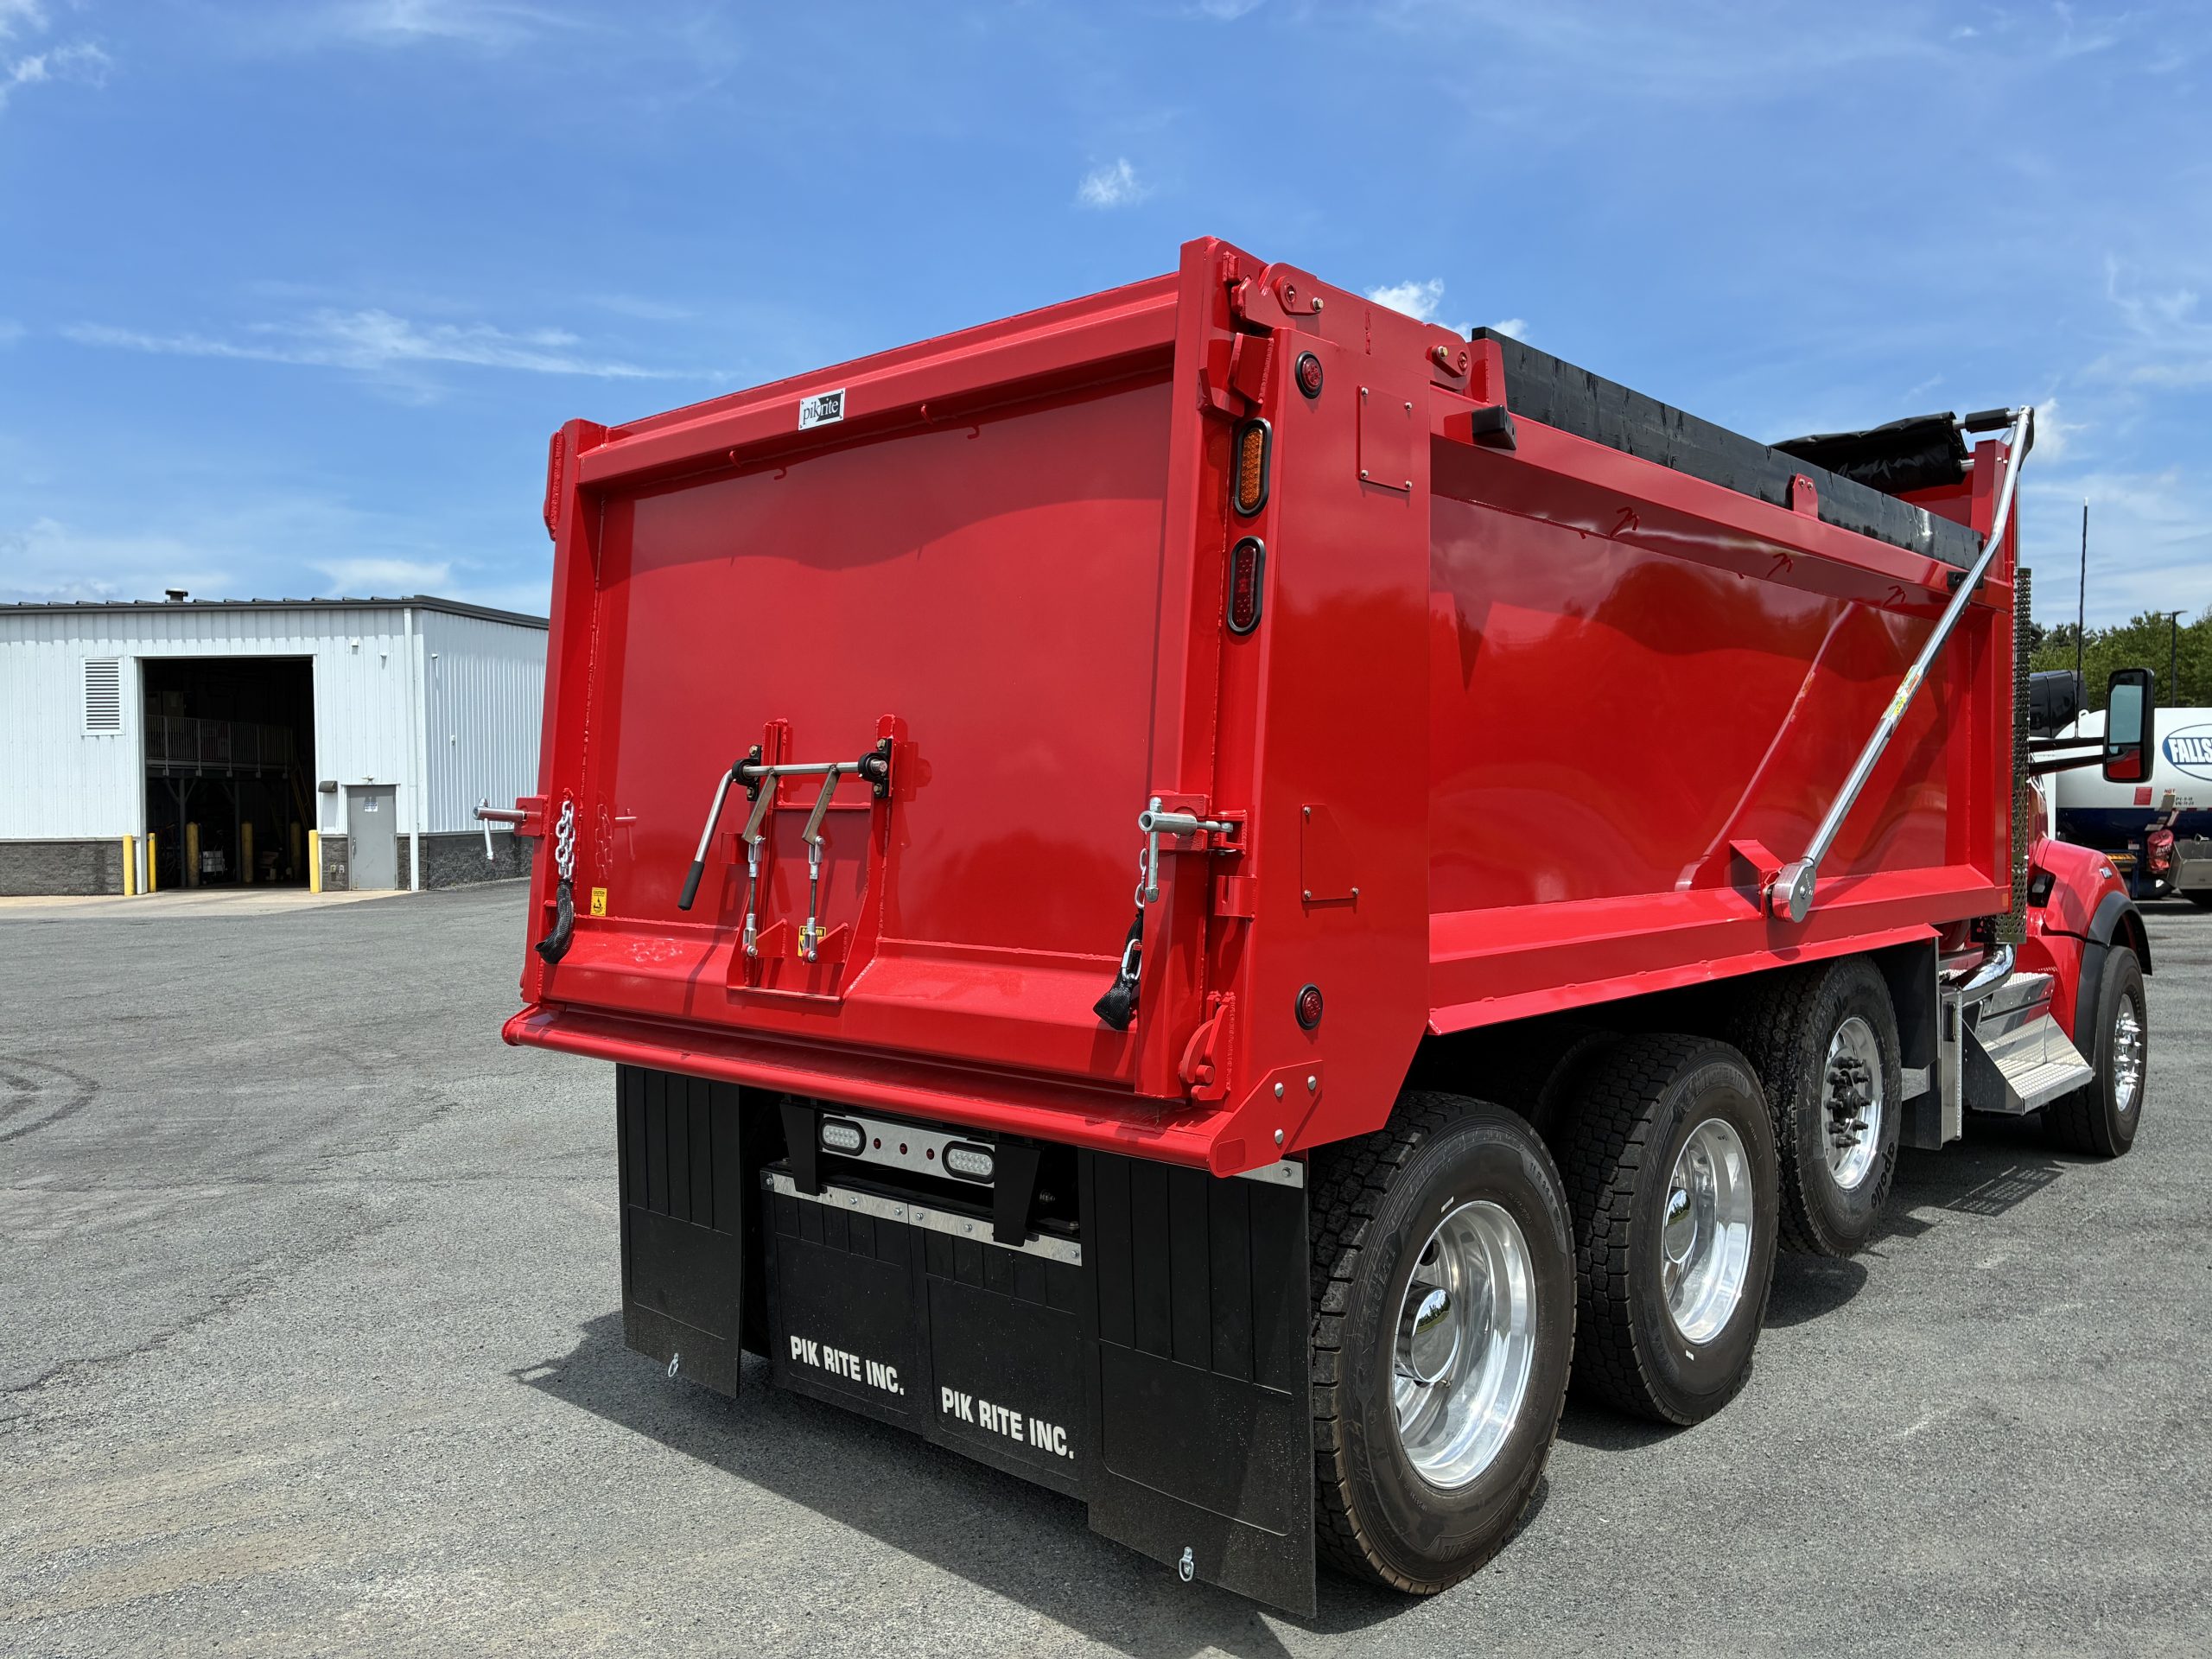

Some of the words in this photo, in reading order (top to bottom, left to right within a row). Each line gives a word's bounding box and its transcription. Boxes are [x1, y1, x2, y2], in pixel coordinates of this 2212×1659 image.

[2168, 738, 2212, 762] FALLS
[1871, 1141, 1895, 1209] apollo
[790, 1335, 820, 1368] PIK
[823, 1345, 861, 1382] RITE
[866, 1359, 905, 1395] INC.
[941, 1387, 974, 1423] PIK
[978, 1400, 1024, 1441] RITE
[1029, 1417, 1075, 1459] INC.
